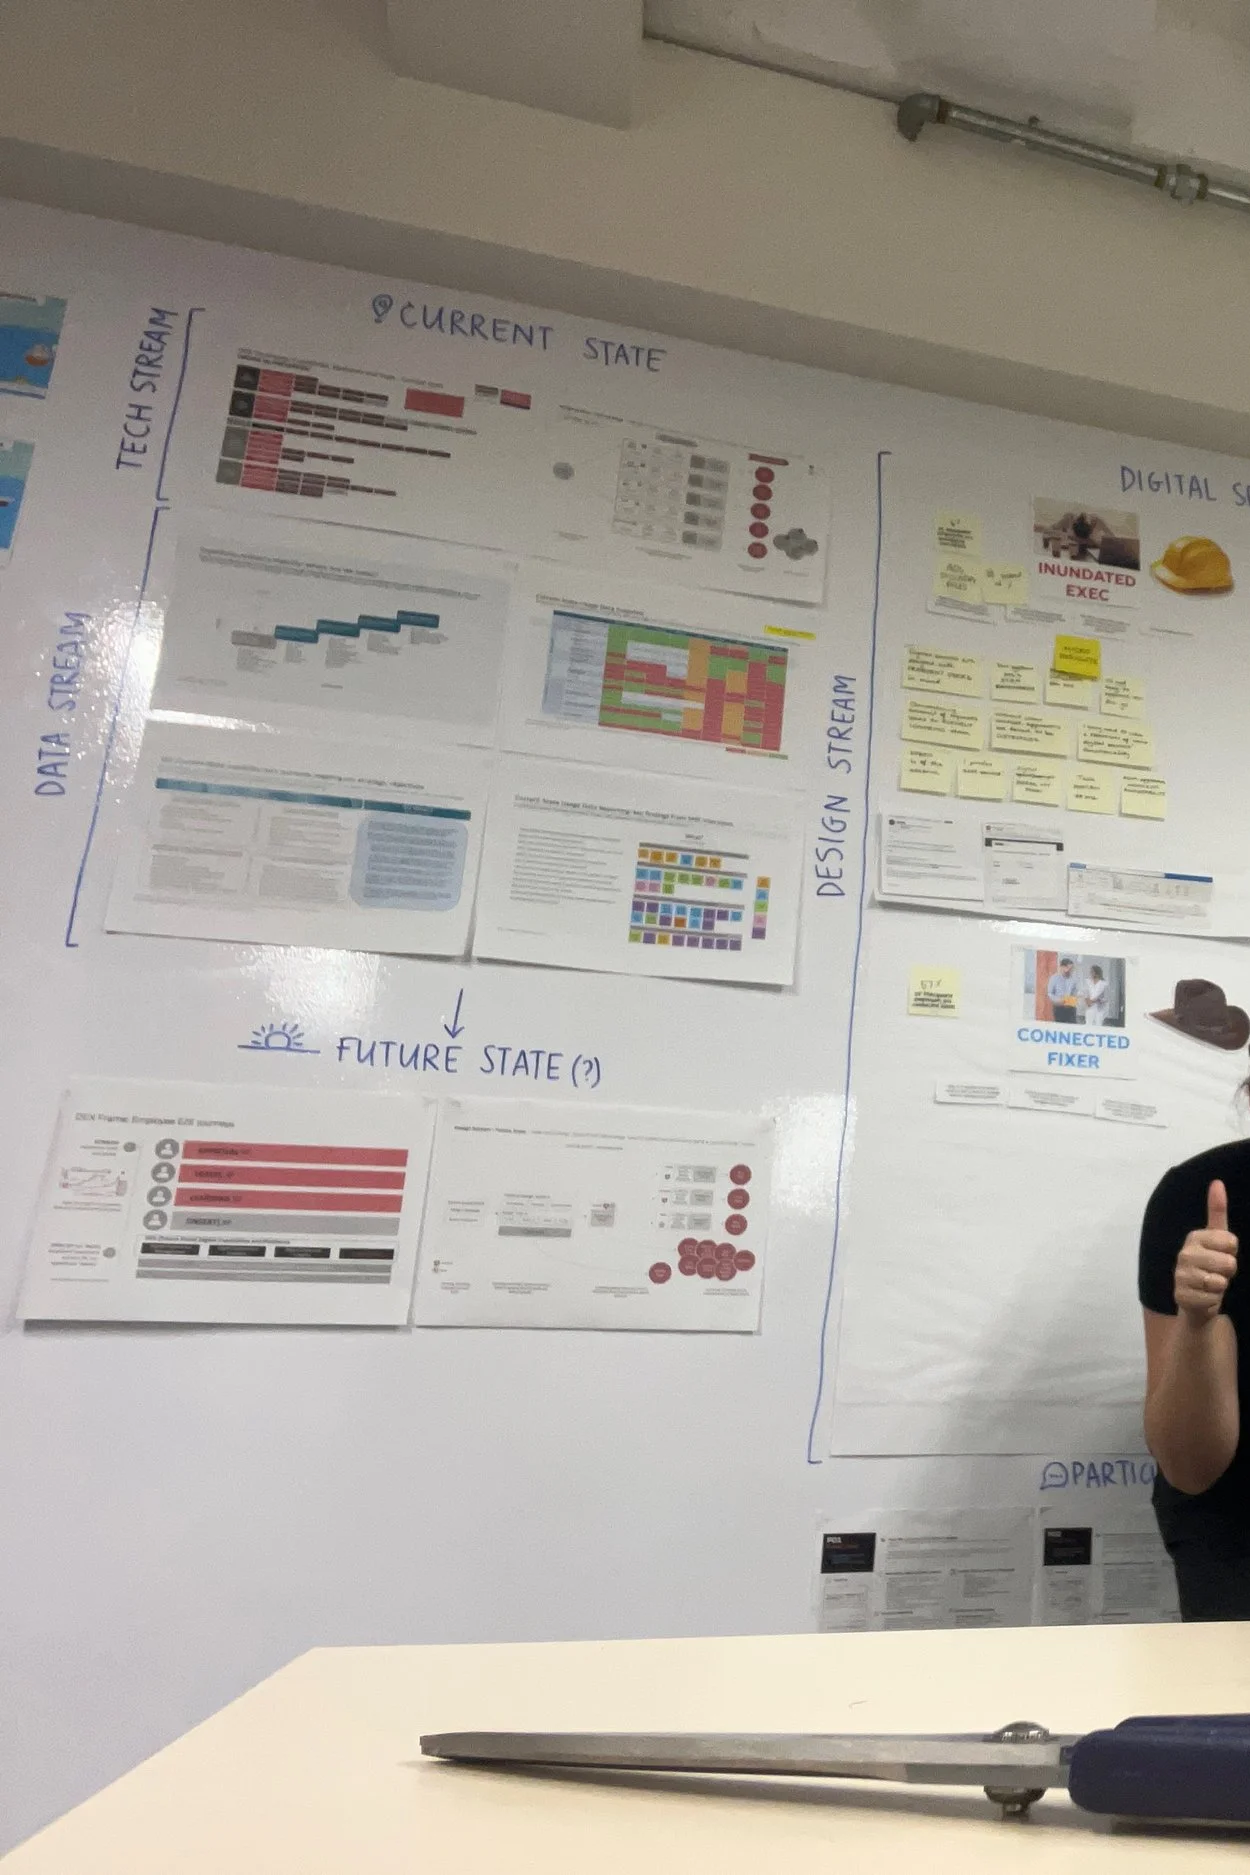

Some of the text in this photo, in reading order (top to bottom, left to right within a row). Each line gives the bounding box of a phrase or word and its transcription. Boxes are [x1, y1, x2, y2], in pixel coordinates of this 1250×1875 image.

[400, 301, 667, 373] CURRENT STATE
[116, 307, 179, 471] TECH STREAM
[1119, 465, 1217, 501] DIGITAL
[1038, 562, 1137, 588] INUNDATED
[1065, 584, 1110, 602] EXEC
[35, 611, 91, 796] DATA STREAM
[815, 674, 856, 896] DESIGN STREAM
[337, 1036, 464, 1074] FUTURE
[480, 1044, 564, 1081] STATE
[1016, 1027, 1131, 1050] CONNECTED
[1047, 1052, 1100, 1069] FIXER
